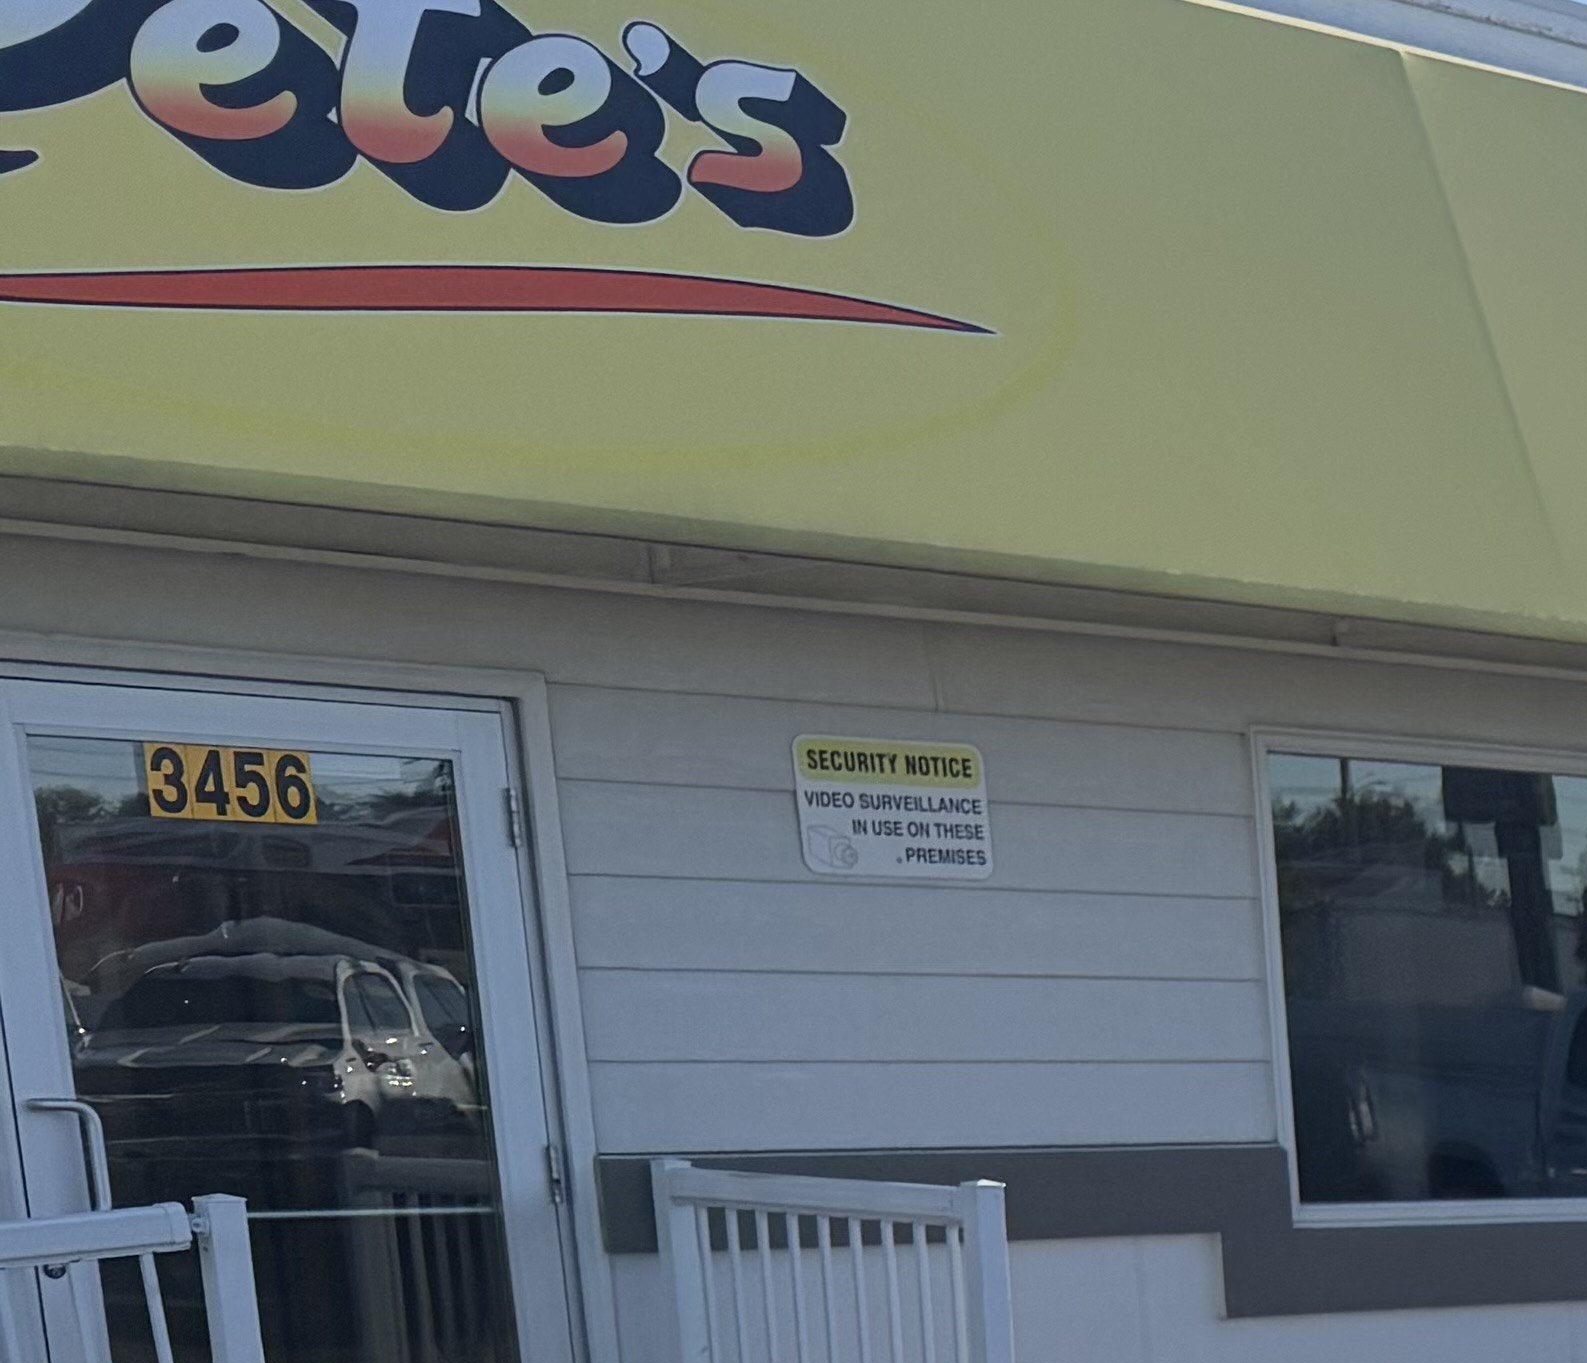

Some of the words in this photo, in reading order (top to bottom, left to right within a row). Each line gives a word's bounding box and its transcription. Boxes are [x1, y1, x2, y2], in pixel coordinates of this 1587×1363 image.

[806, 748, 898, 774] SECURITY
[904, 754, 973, 778] NOTICE
[151, 747, 311, 820] 3456
[803, 790, 855, 809] VIDEO
[859, 793, 982, 815] SURVEILLANCE
[851, 819, 868, 835] IN
[872, 820, 904, 836] USE
[907, 821, 930, 838] ON
[933, 823, 985, 840] THESE
[905, 847, 987, 866] PREMISES
